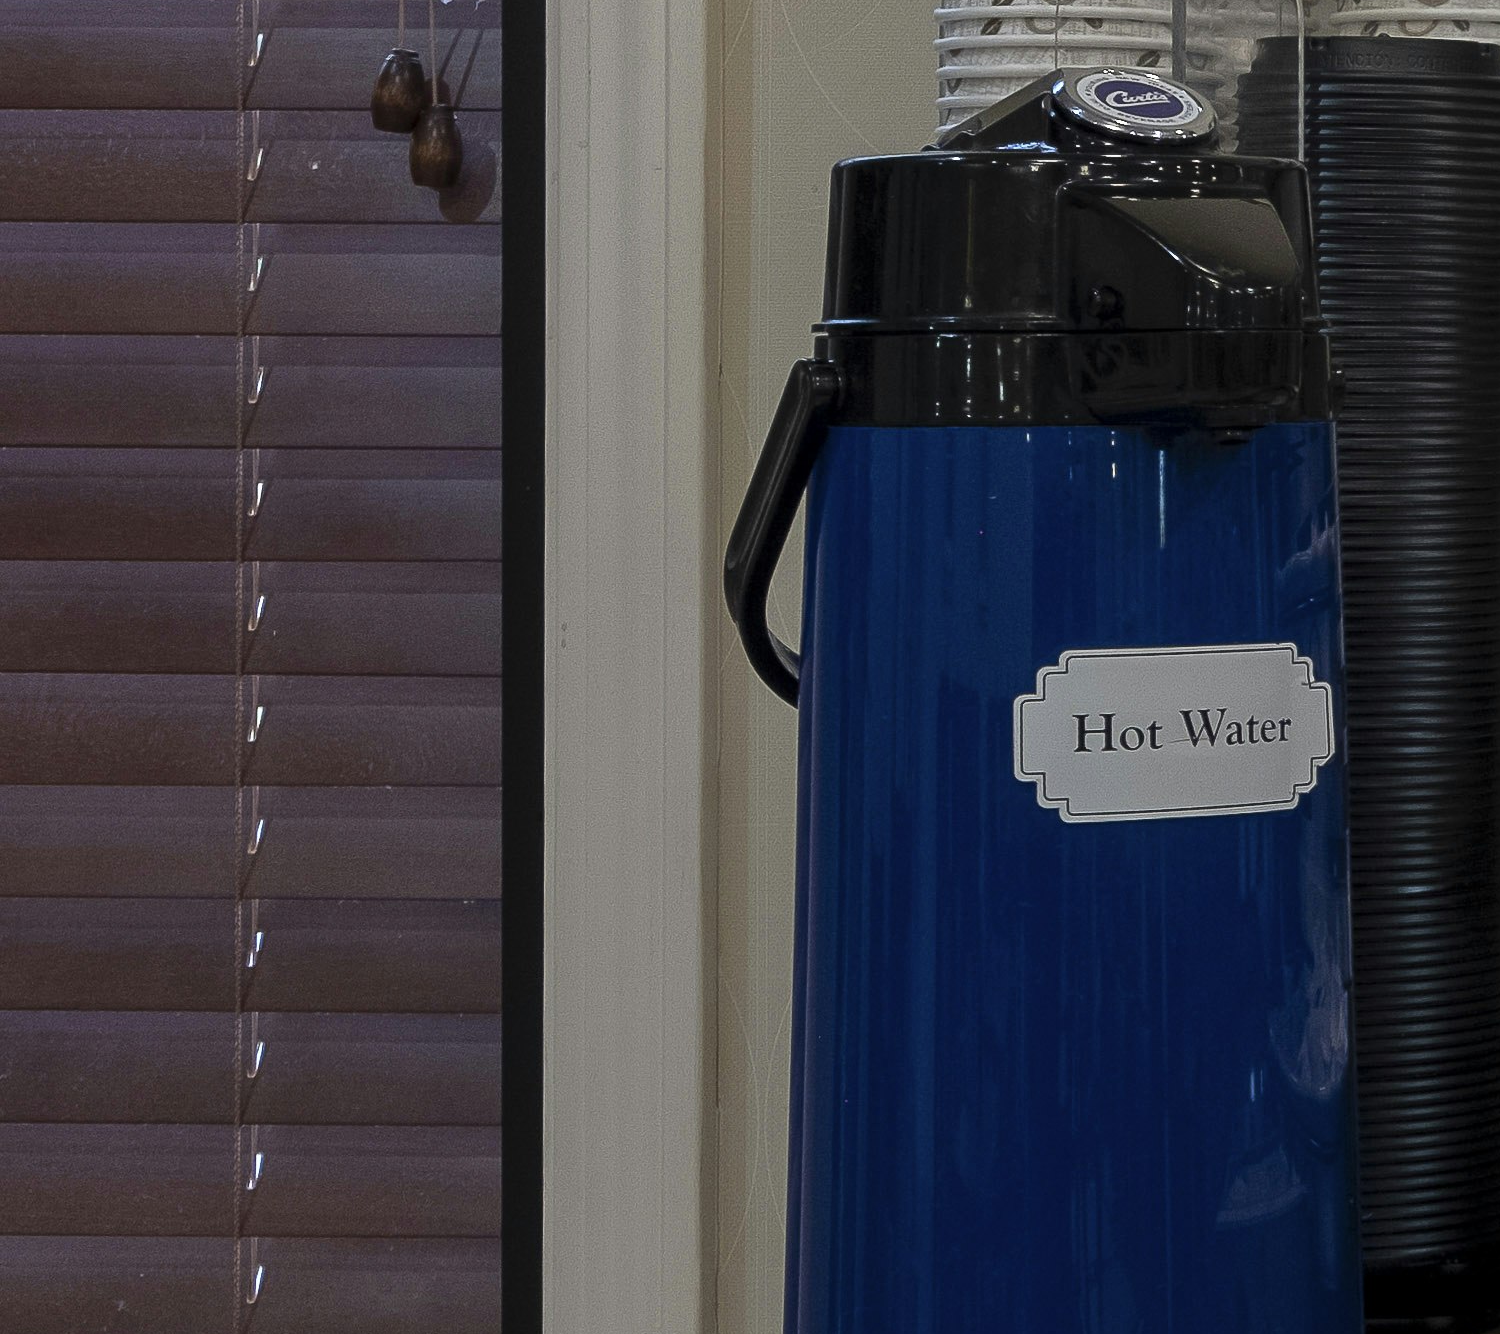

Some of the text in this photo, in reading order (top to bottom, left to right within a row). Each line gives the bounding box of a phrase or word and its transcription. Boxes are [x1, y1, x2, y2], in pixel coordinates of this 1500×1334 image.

[1105, 90, 1171, 108] Curtis
[1072, 707, 1293, 753] Hot Water
